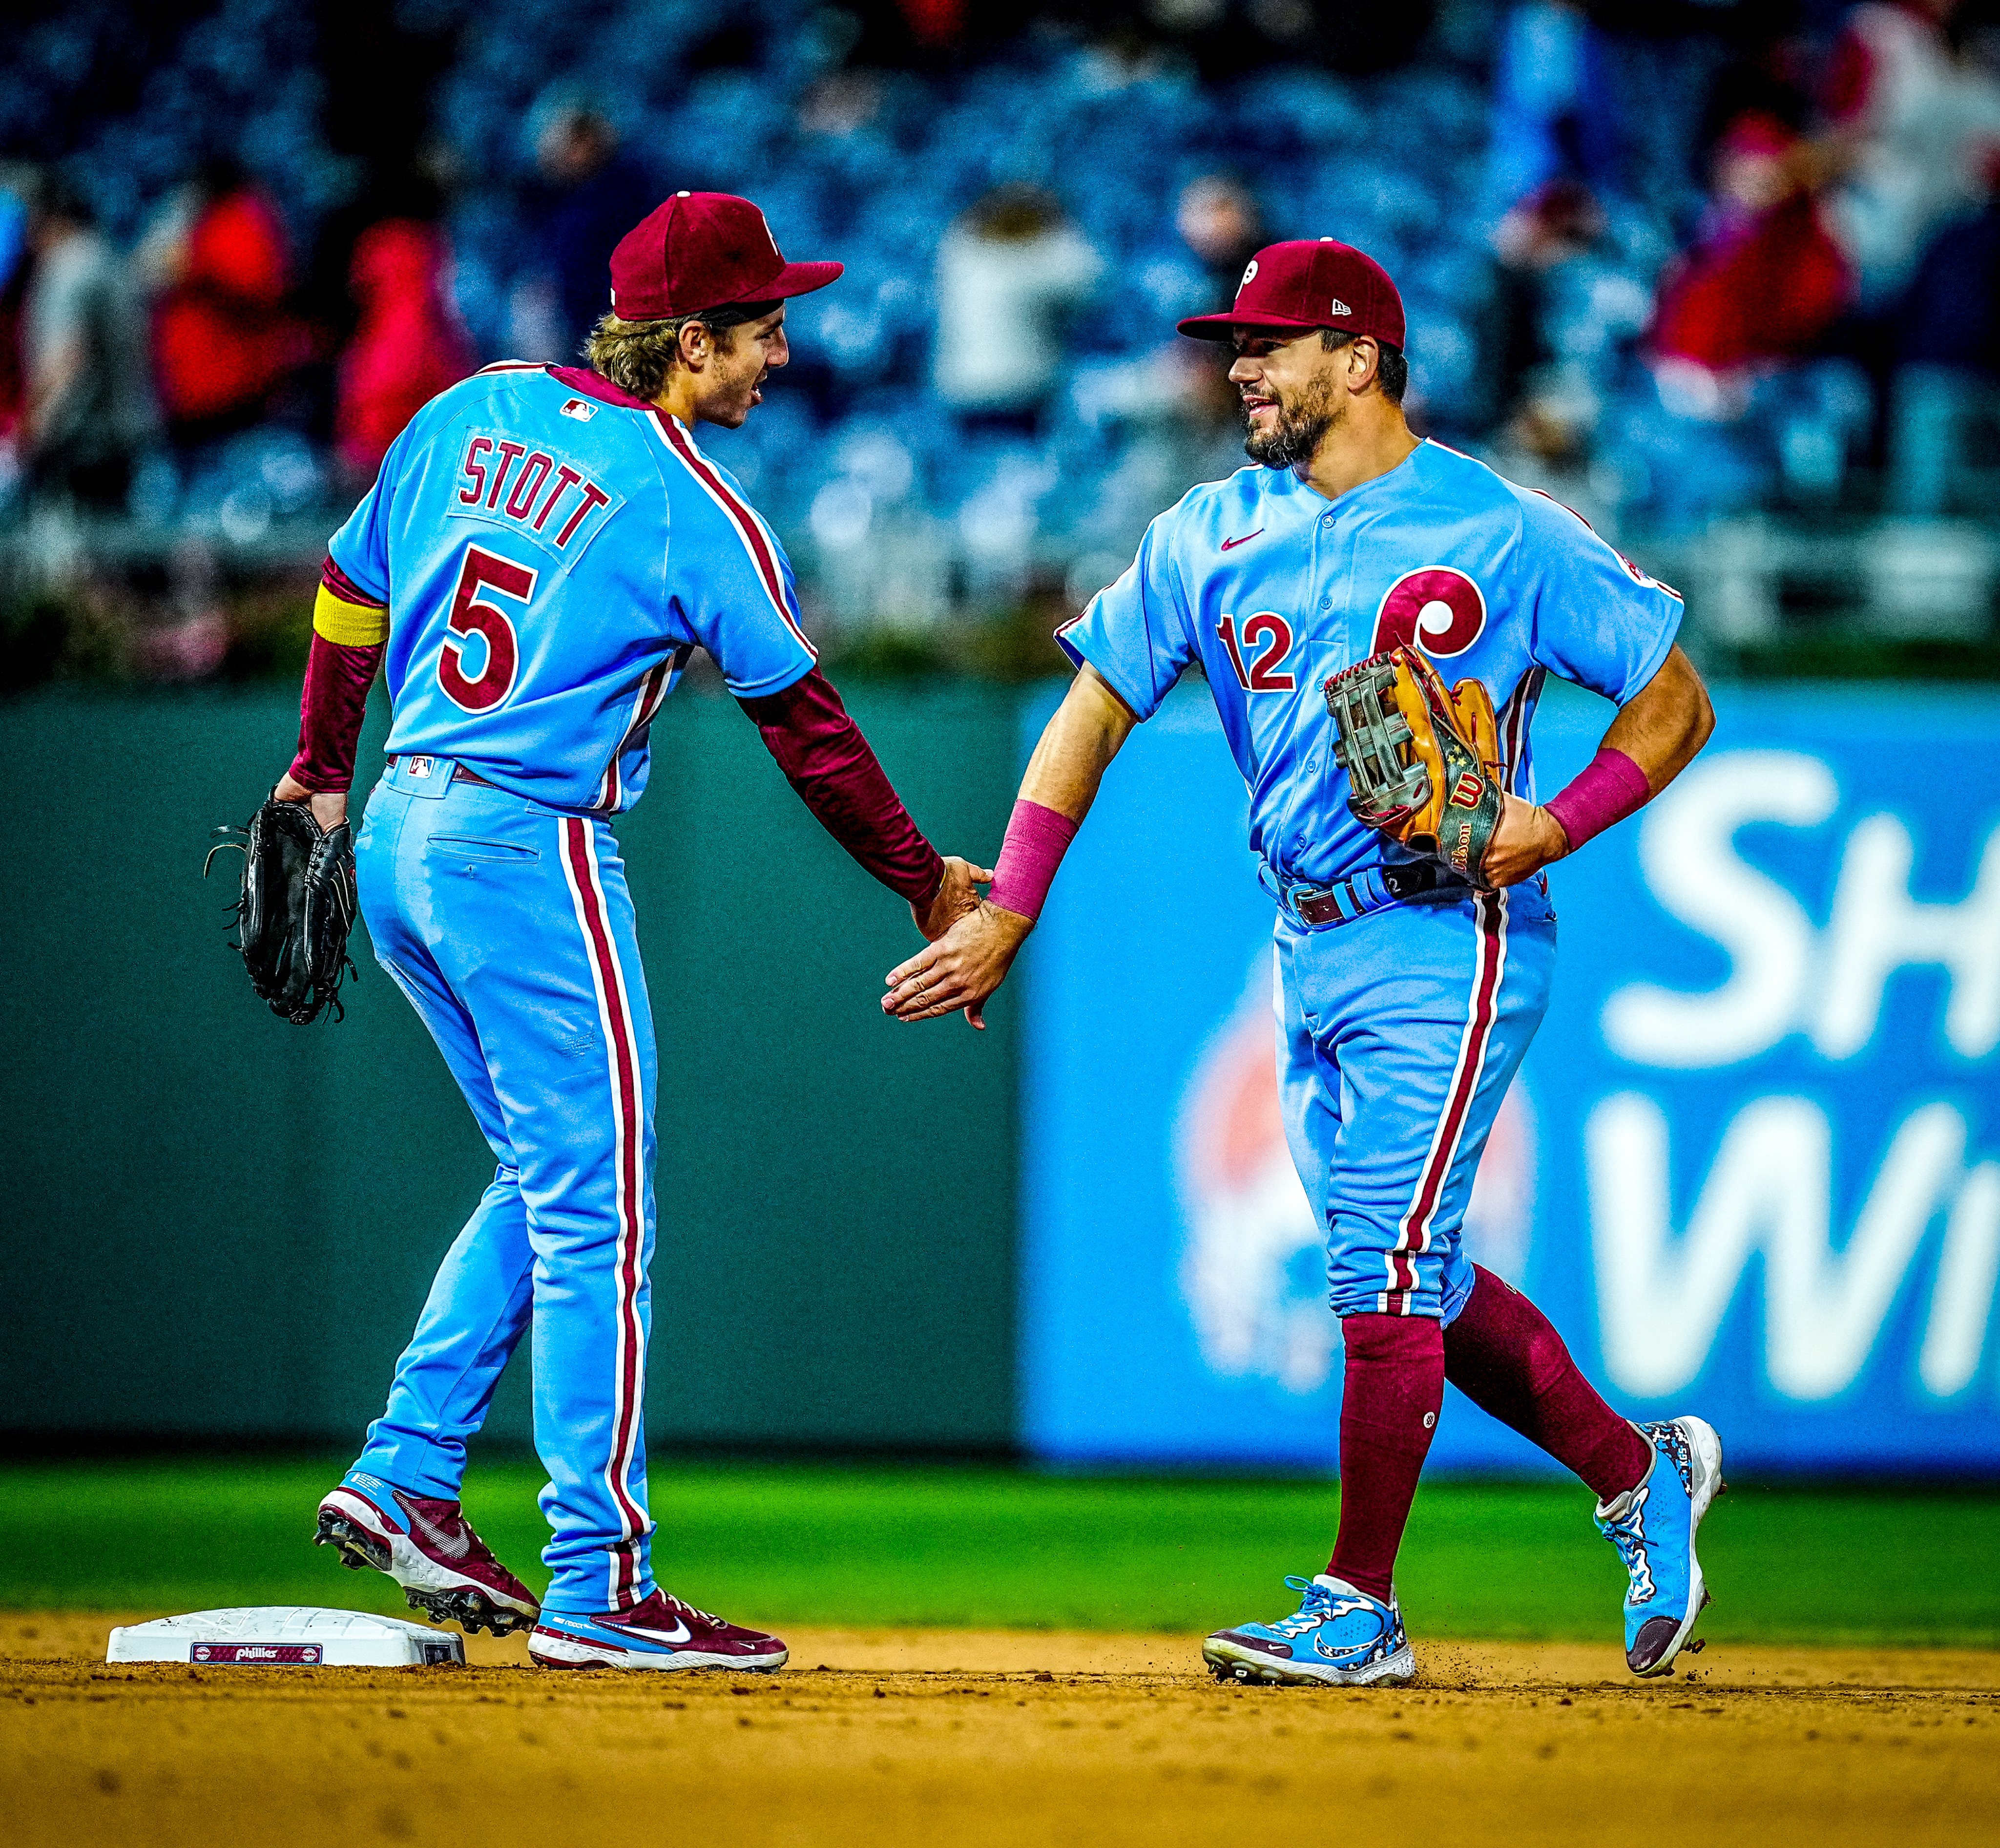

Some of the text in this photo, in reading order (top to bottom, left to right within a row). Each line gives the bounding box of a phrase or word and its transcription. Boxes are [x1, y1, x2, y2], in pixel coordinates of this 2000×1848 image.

[458, 437, 611, 551] STOTT
[436, 541, 539, 714] 5
[1215, 610, 1297, 693] 12
[1368, 565, 1487, 659] P
[1449, 771, 1485, 810] W
[235, 1647, 278, 1661] phillies
